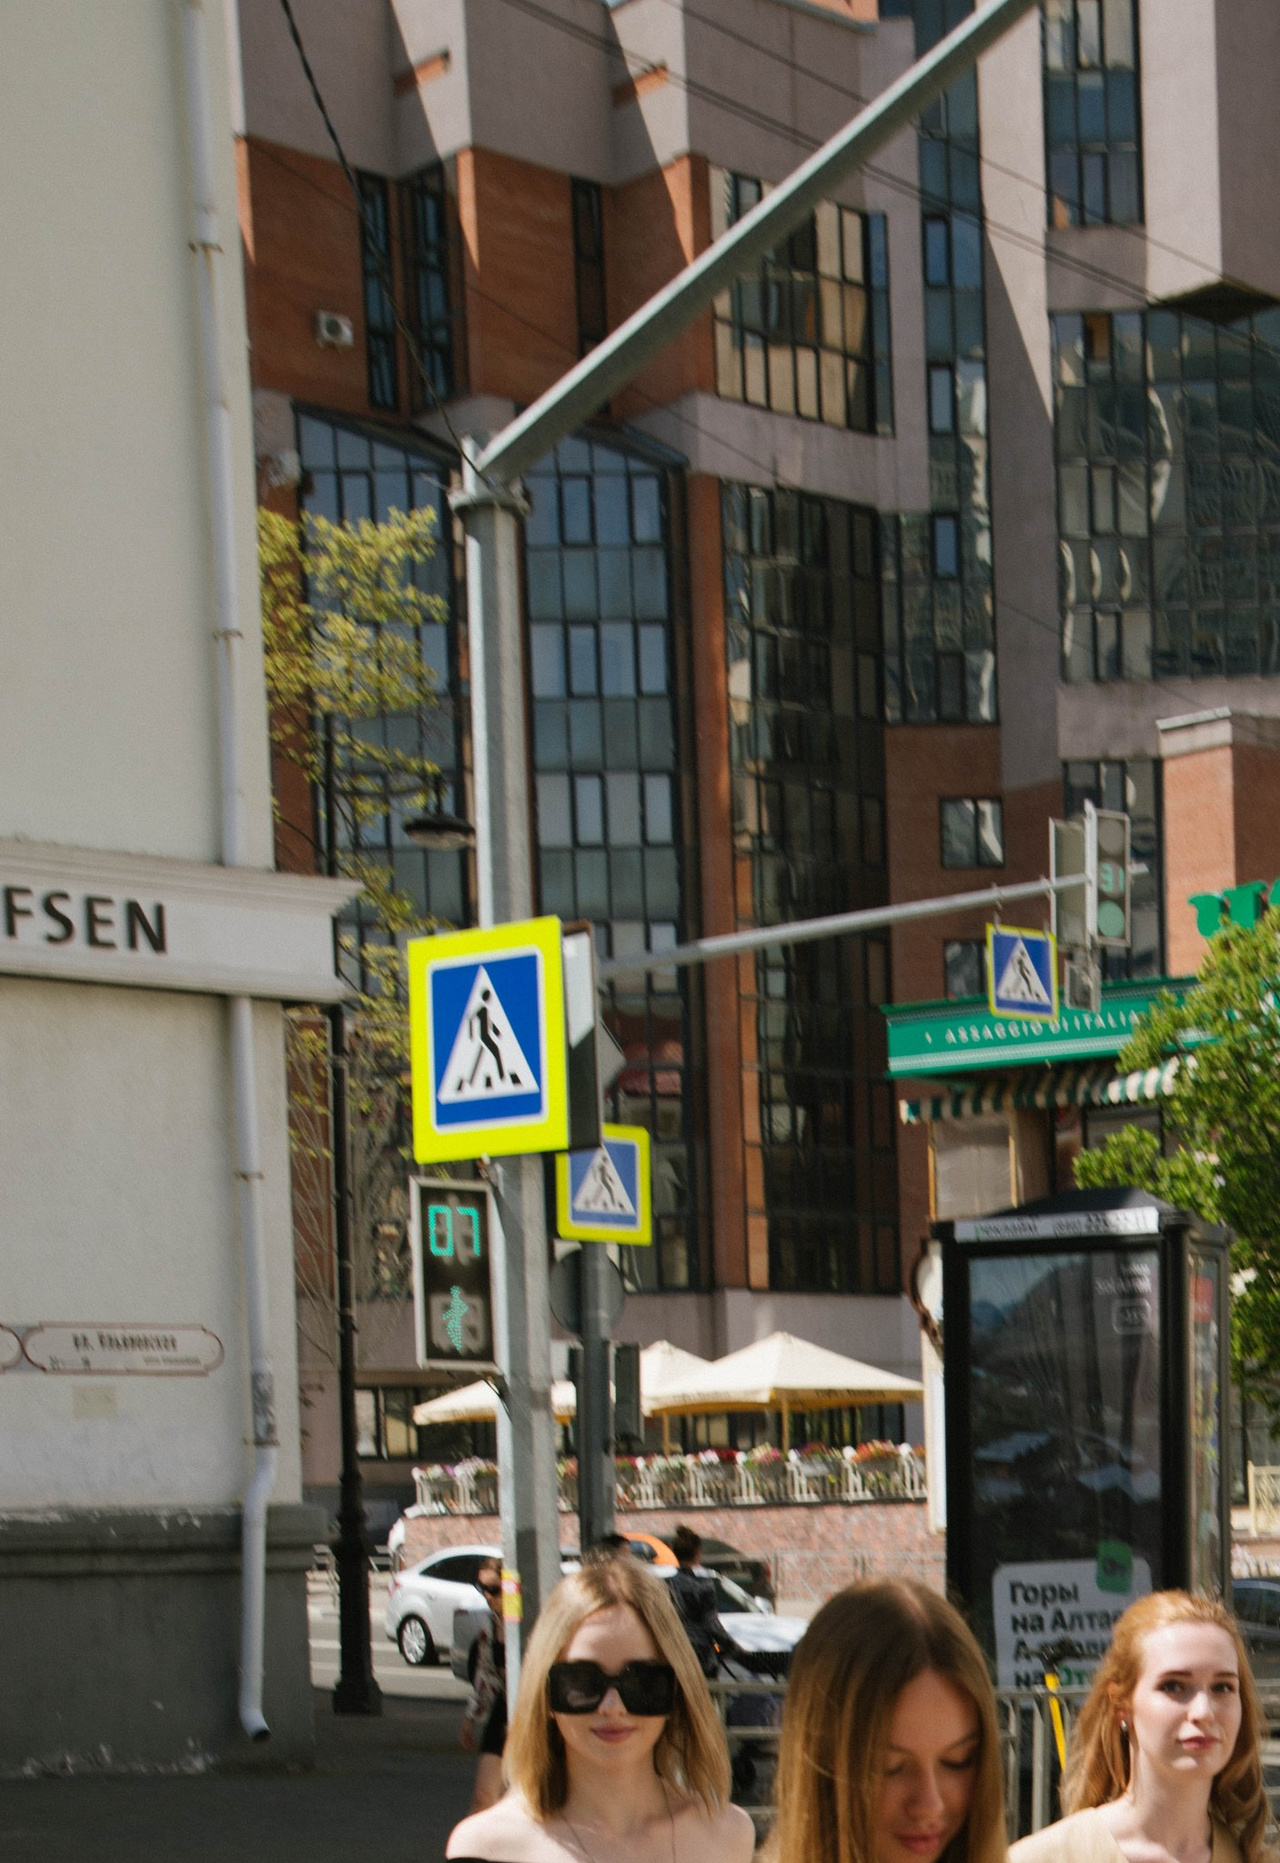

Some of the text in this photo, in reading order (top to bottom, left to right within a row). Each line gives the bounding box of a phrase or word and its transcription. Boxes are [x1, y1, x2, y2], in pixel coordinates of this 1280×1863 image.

[1101, 861, 1125, 893] 31
[4, 885, 167, 955] FSEN
[428, 1204, 481, 1257] 07
[1010, 1580, 1080, 1608] Горы
[1011, 1613, 1045, 1634] на
